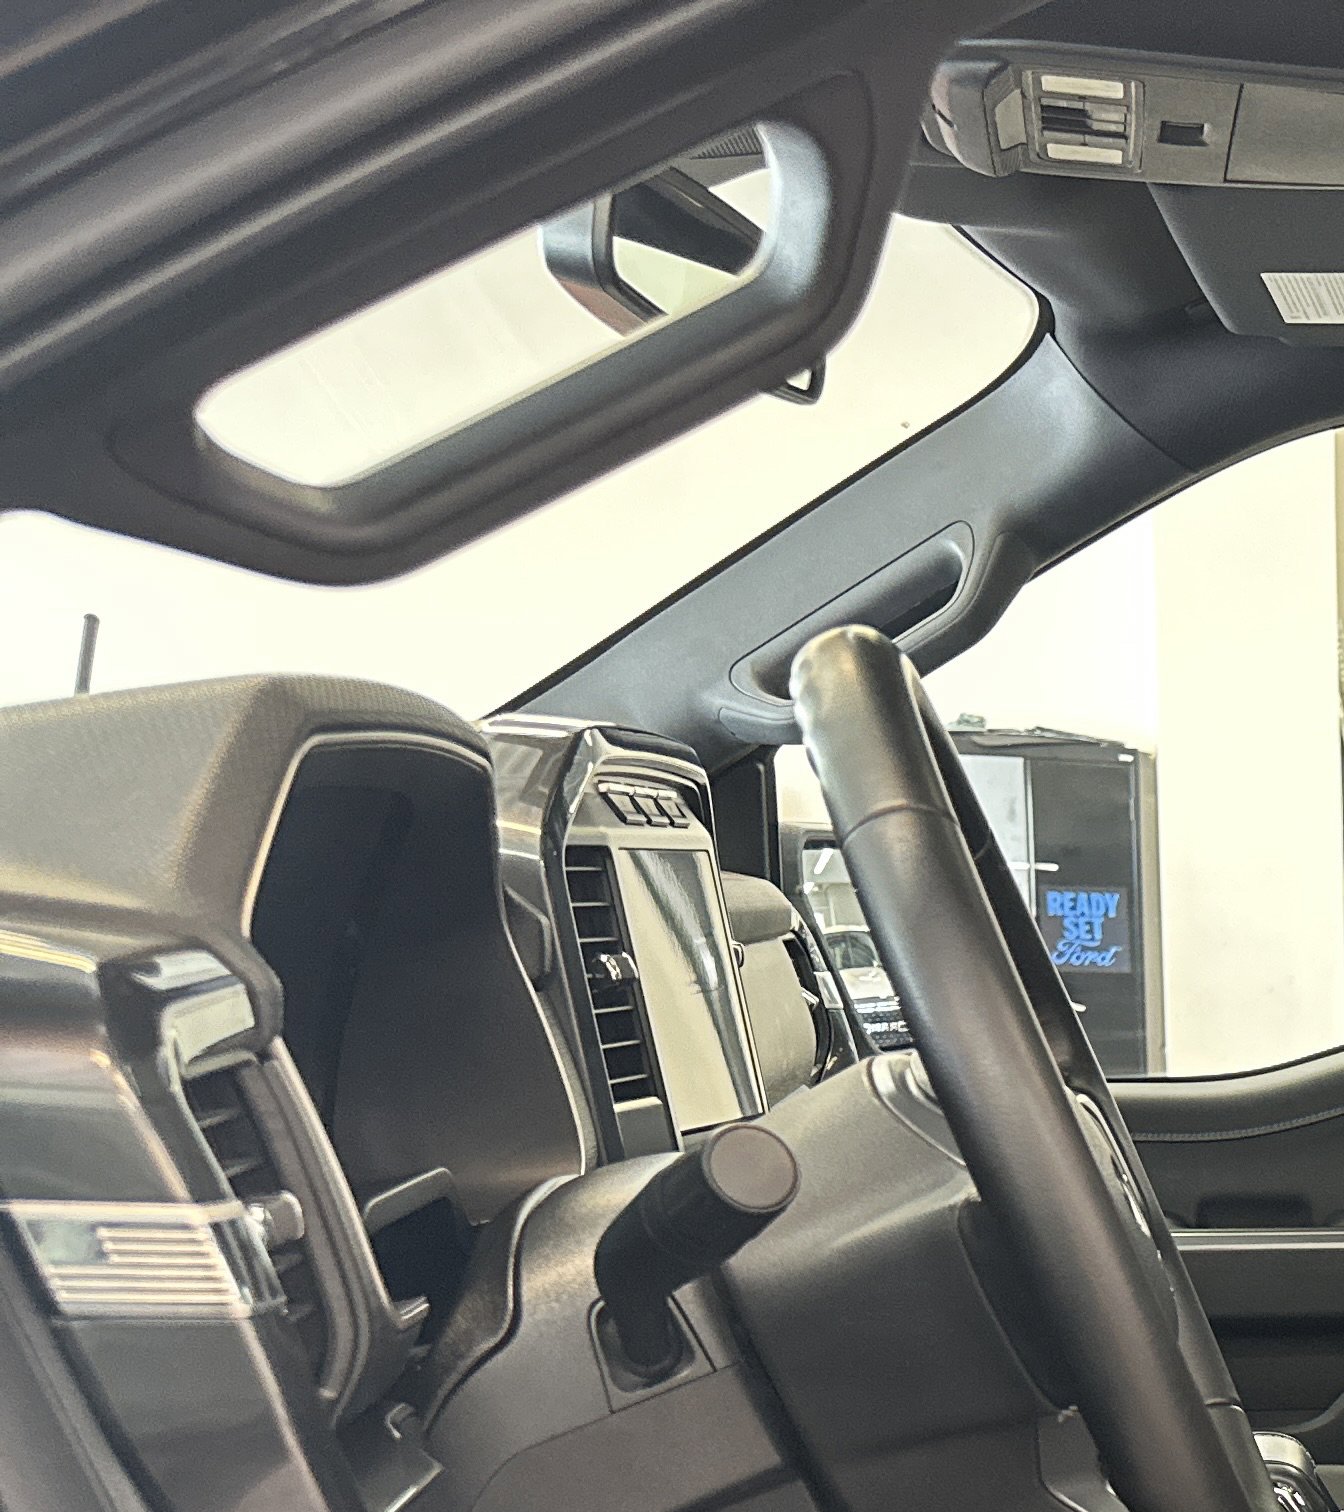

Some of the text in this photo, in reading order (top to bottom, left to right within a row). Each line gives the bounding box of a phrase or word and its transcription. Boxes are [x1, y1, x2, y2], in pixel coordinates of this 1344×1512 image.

[1045, 891, 1120, 917] READY
[1063, 916, 1104, 940] SET
[1051, 938, 1122, 967] Ford
